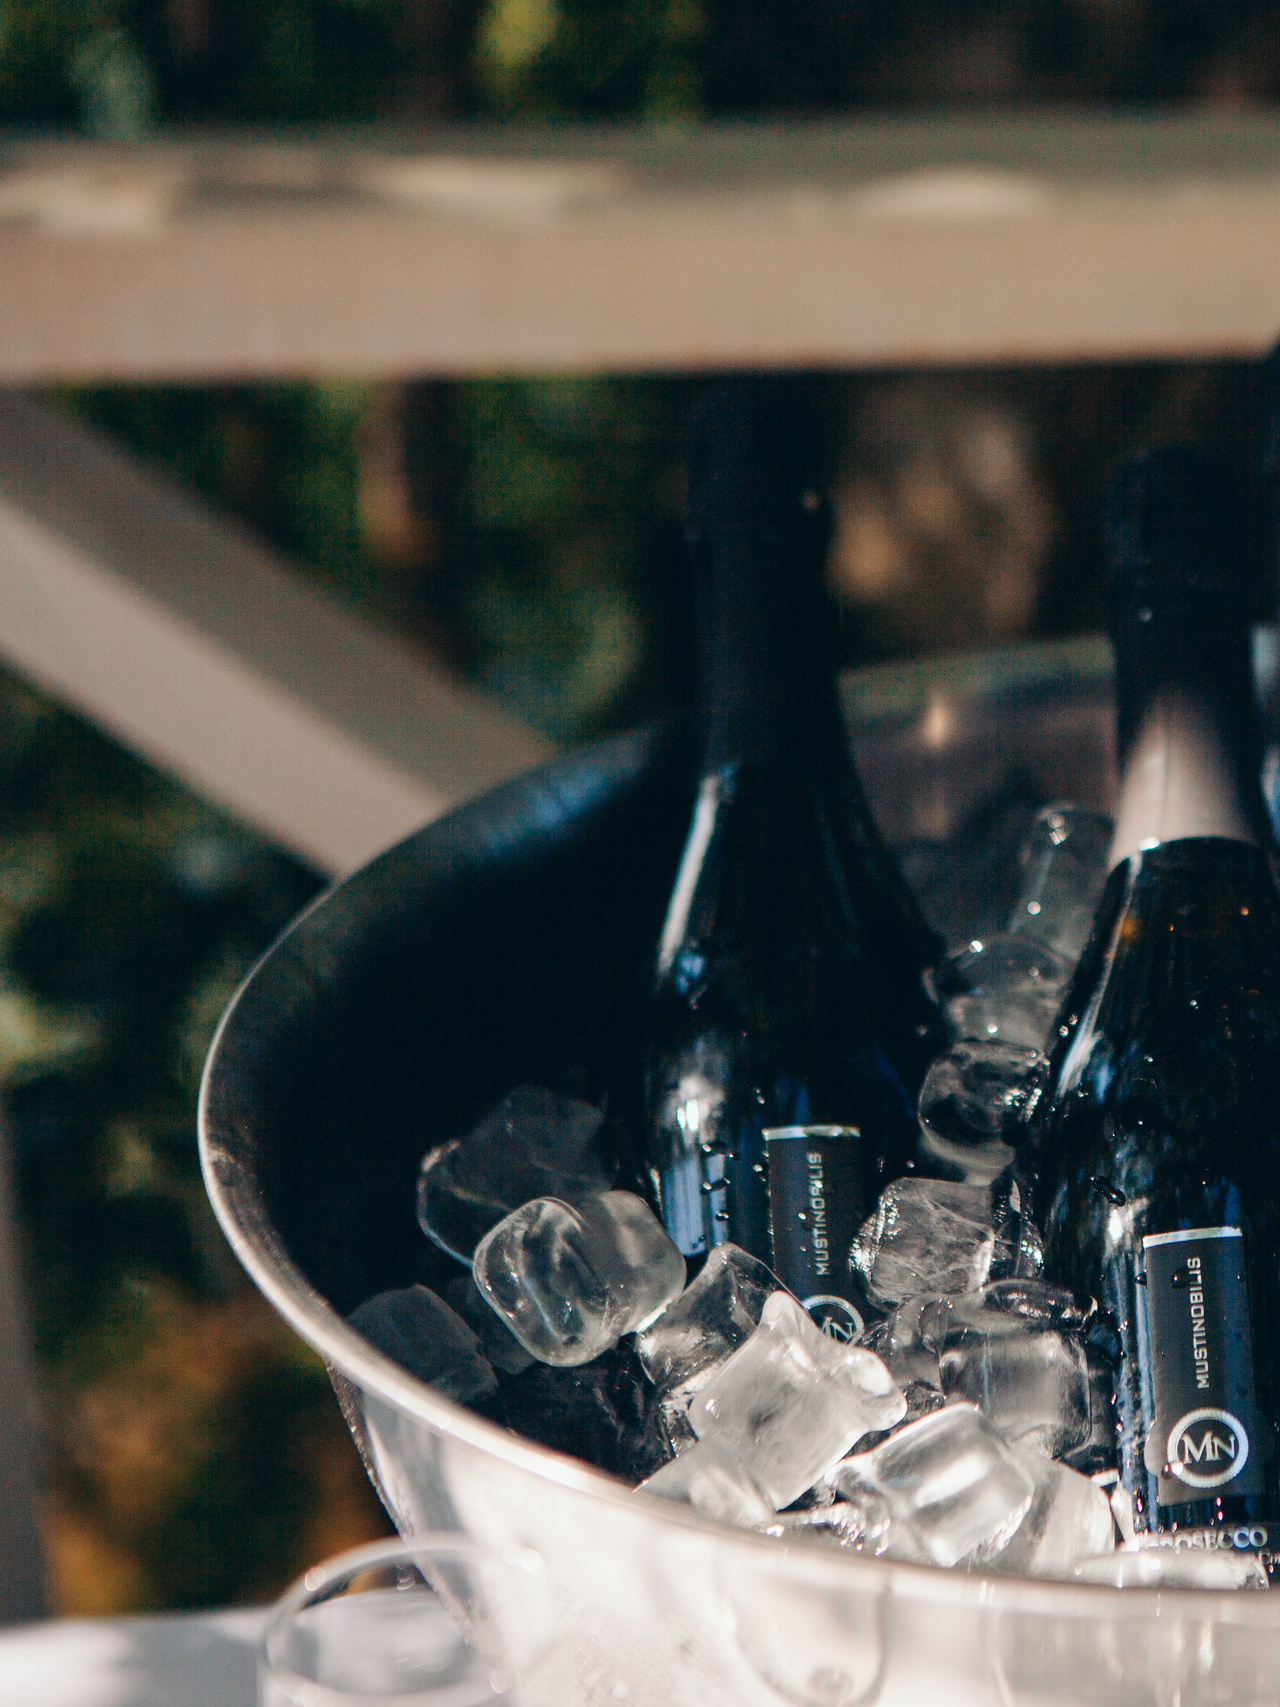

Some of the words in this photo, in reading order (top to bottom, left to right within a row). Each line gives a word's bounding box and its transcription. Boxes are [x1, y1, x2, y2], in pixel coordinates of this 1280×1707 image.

[1187, 1257, 1210, 1389] MUSTINOBILIS
[1181, 1430, 1236, 1465] MN
[1146, 1525, 1268, 1549] OSECCO
